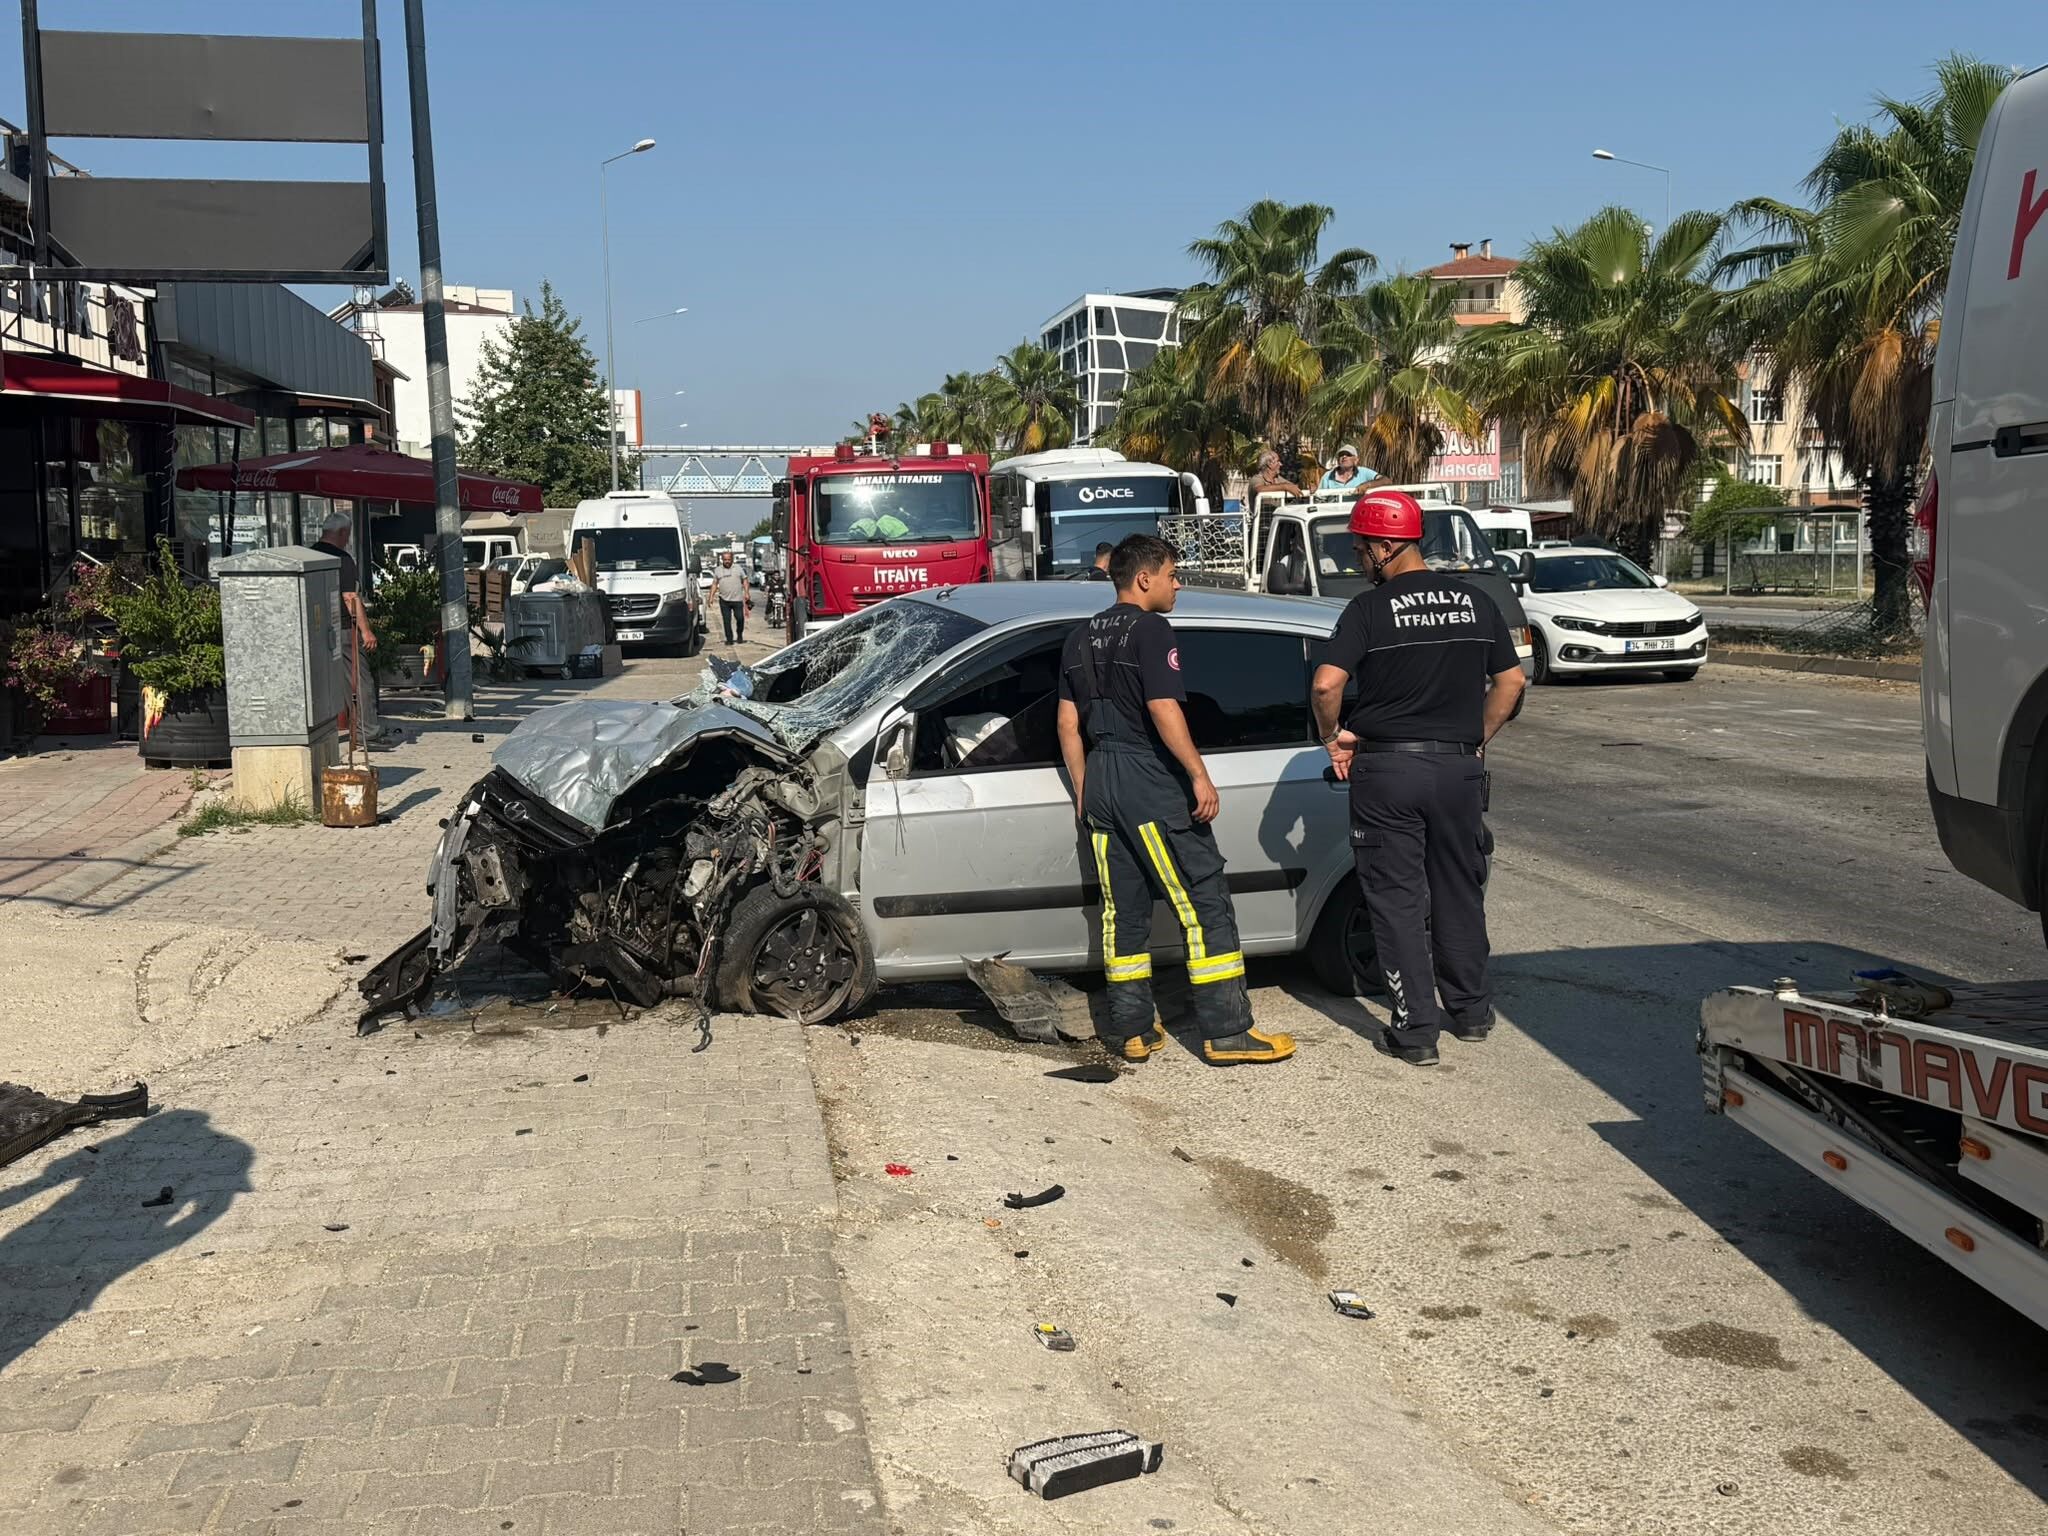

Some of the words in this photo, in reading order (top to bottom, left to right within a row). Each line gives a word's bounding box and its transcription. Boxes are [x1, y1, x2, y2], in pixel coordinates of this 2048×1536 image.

[852, 476, 895, 485] ANTALYA
[1095, 486, 1135, 499] ÖNCE
[883, 550, 917, 559] IVECO
[873, 566, 928, 584] İTFAİYE
[1390, 590, 1474, 614] ANTALYA
[1394, 609, 1477, 628] İTFAİYESİ
